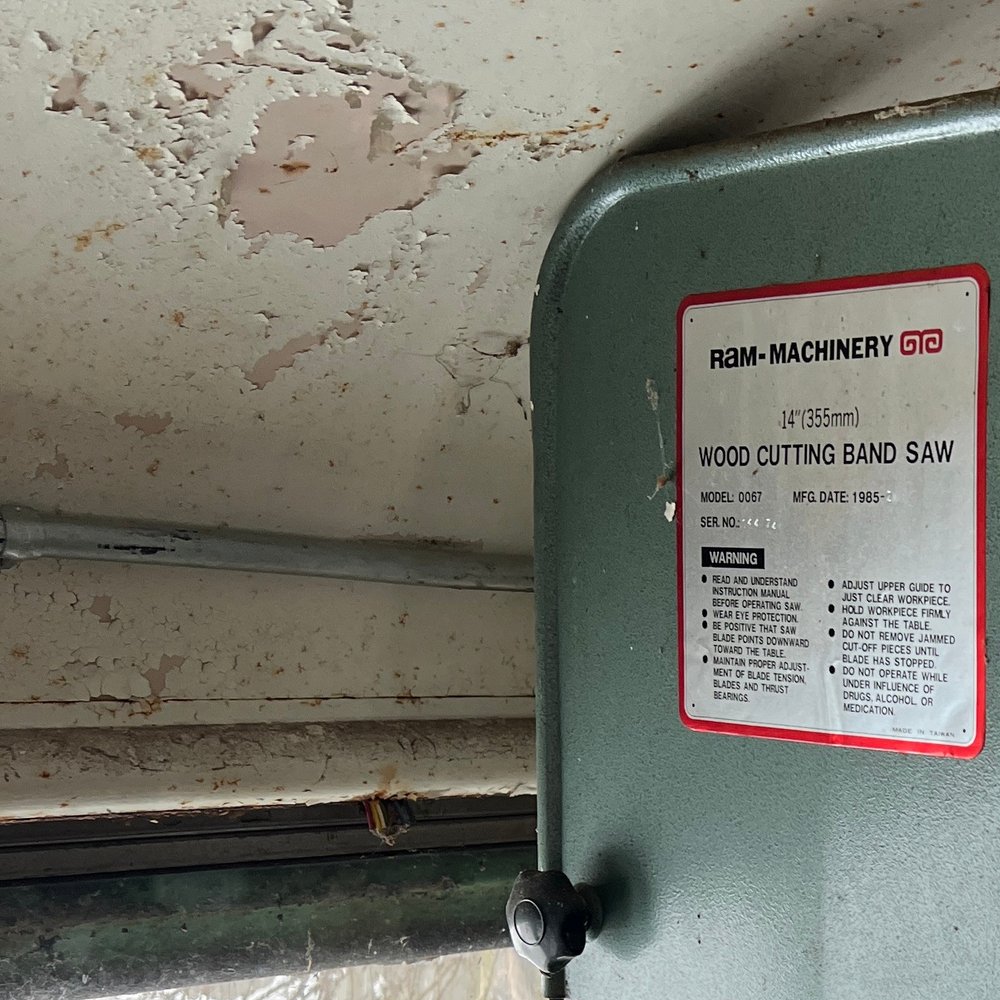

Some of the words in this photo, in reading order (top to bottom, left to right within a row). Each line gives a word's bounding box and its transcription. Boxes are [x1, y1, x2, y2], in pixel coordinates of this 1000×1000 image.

[699, 446, 750, 467] WOOD
[757, 444, 835, 466] CUTTING
[843, 442, 896, 465] BAND
[906, 440, 954, 464] SAW
[700, 491, 734, 503] MODEL:
[739, 491, 762, 503] 0067
[820, 491, 849, 503] DATE:
[709, 551, 758, 565] WARNING
[712, 575, 730, 584] READ
[734, 576, 748, 585] AND
[751, 577, 798, 587] UNDERSTAND
[842, 581, 874, 590] ADJUST
[878, 582, 905, 591] UPPER
[909, 583, 934, 592] GUIDE
[939, 584, 951, 593] TO
[712, 587, 758, 597] INSTRUCTION
[761, 589, 789, 599] MANUAL
[842, 593, 862, 602] JUST
[866, 594, 893, 603] CLEAR
[712, 599, 739, 608] BEFORE
[742, 600, 781, 610] OPERATING
[713, 610, 732, 619] WEAR
[736, 611, 749, 620] EYE
[842, 605, 863, 614] HOLD
[868, 606, 917, 617] WORKPIECE
[921, 609, 951, 619] FIRMLY
[713, 622, 721, 630] BE
[725, 622, 756, 632] POSITIVE
[759, 624, 777, 633] THAT
[780, 626, 796, 635] SAW
[842, 618, 879, 627] AGAINST
[883, 619, 899, 629] THE
[713, 633, 735, 642] BLADE
[738, 635, 763, 644] POINTS
[766, 636, 809, 647] DOWNWARD
[842, 630, 854, 639] DO
[858, 630, 875, 640] NOT
[880, 632, 914, 642] REMOVE
[919, 634, 955, 644] JAMMED
[714, 645, 742, 654] TOWARD
[746, 646, 759, 656] THE
[763, 648, 786, 658] TABLE.
[842, 642, 877, 652] CUT-OFF
[882, 644, 911, 654] PIECES
[915, 646, 939, 656] UNTIL
[713, 657, 745, 666] MAINTAIN
[749, 659, 776, 669] PROPER
[779, 661, 809, 671] ADJUST-
[842, 654, 869, 664] BLADE
[873, 656, 890, 666] HAS
[713, 668, 732, 677] MENT
[736, 669, 744, 678] OF
[748, 671, 770, 681] BLADE
[843, 667, 854, 675] DO
[858, 667, 875, 677] NOT
[879, 669, 917, 680] OPERATE
[921, 672, 948, 682] WHILE
[713, 680, 740, 689] BLADES
[744, 682, 758, 691] AND
[762, 683, 788, 694] THRUST
[843, 679, 870, 689] UNDER
[874, 681, 919, 692] INFLUENCE
[923, 685, 934, 693] OF
[714, 691, 750, 702] BEARINGS.
[921, 697, 933, 706] OR
[929, 730, 955, 738] TAIWAN
